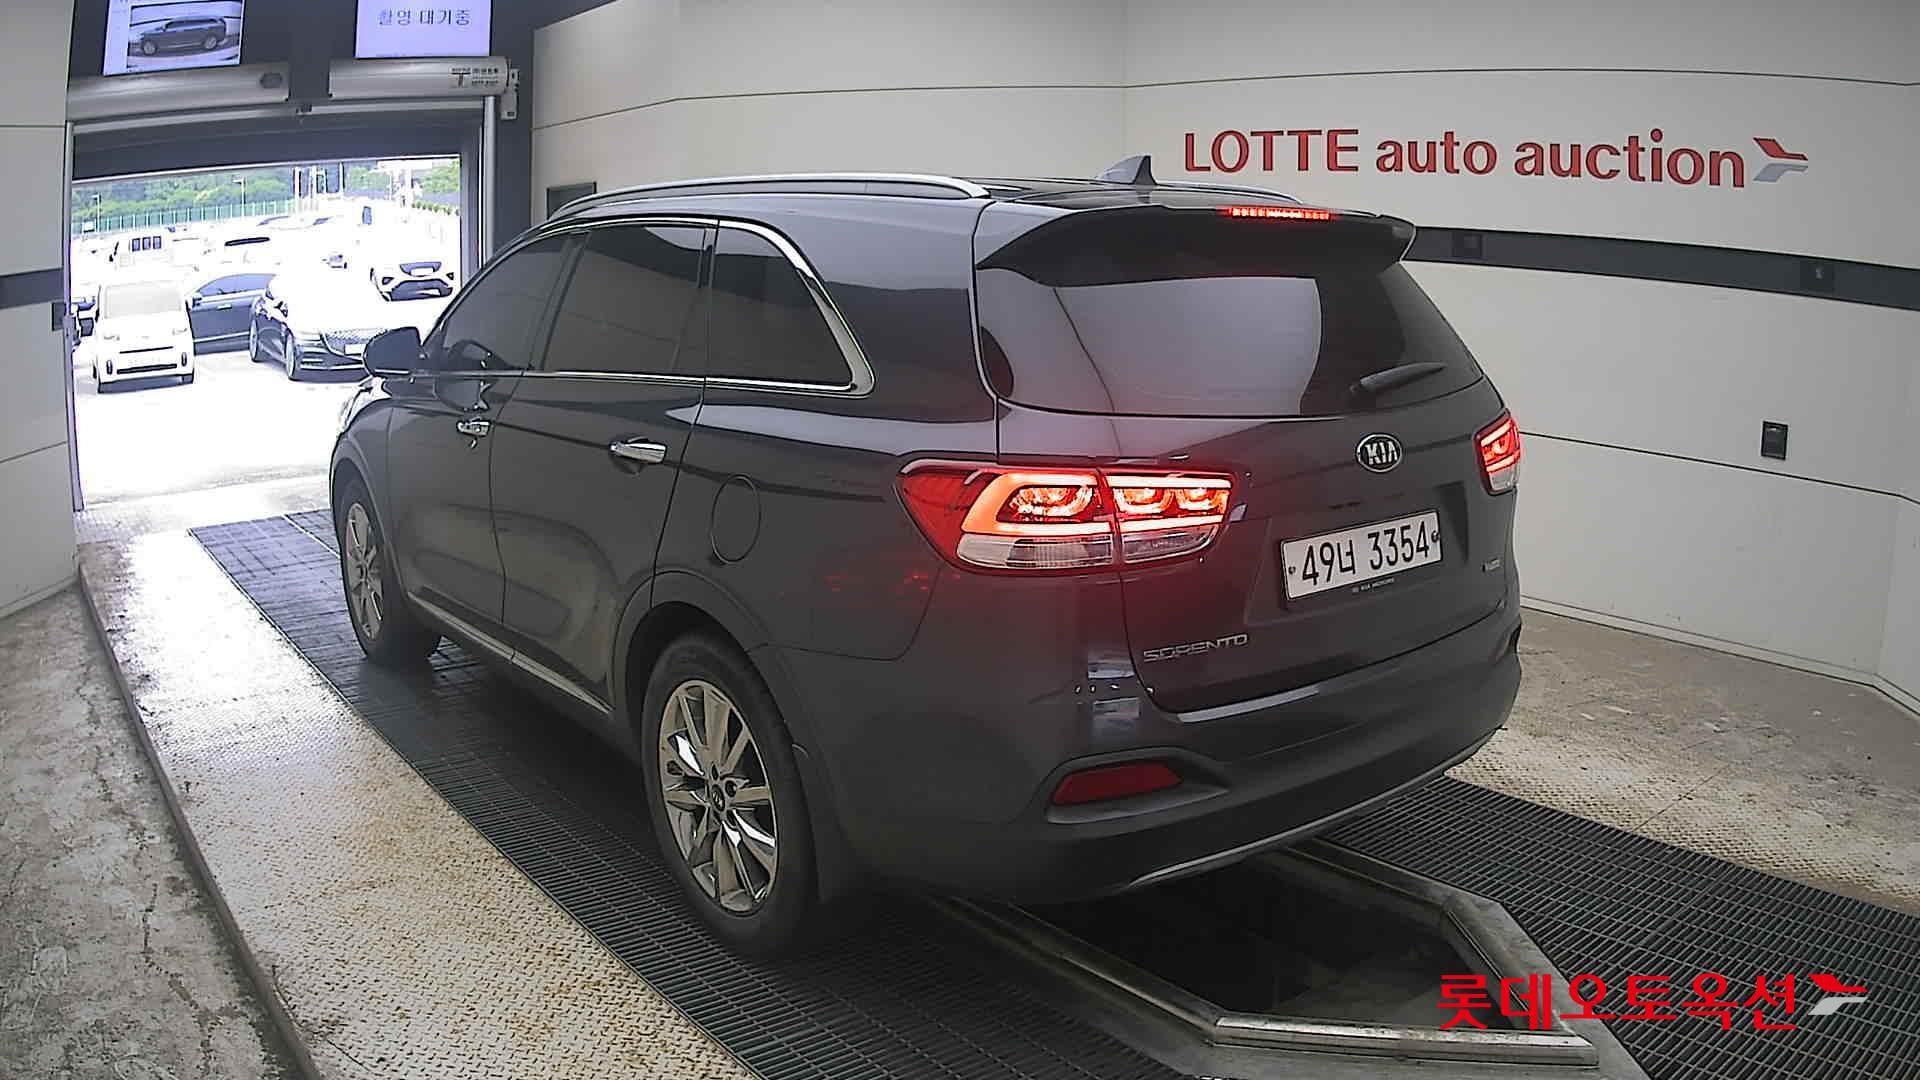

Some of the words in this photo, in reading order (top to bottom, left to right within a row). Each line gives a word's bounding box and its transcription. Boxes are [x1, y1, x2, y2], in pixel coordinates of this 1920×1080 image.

[420, 9, 470, 26] 대기중
[1184, 129, 1359, 174] LOTTE
[1375, 131, 1498, 176] auto
[1514, 128, 1745, 188] auction
[1364, 440, 1398, 465] KIA
[1302, 539, 1356, 586] 49너
[1367, 520, 1430, 571] 3354
